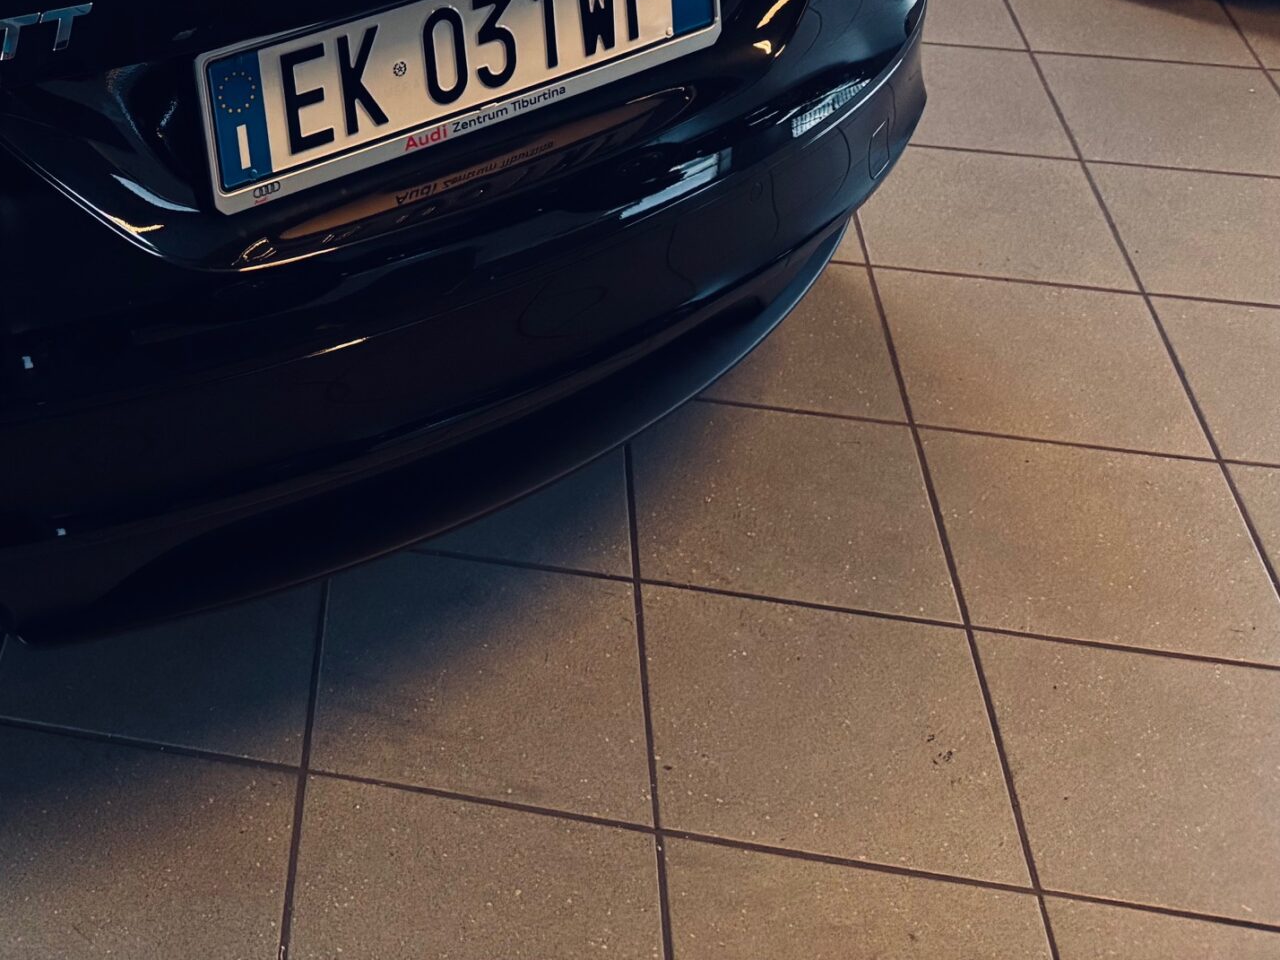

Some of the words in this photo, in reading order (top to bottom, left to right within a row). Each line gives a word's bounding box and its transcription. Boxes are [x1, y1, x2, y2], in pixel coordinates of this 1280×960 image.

[279, 23, 390, 156] EK
[405, 124, 449, 152] Audi
[452, 106, 509, 134] Zentrum
[510, 85, 567, 113] Tiburtina
